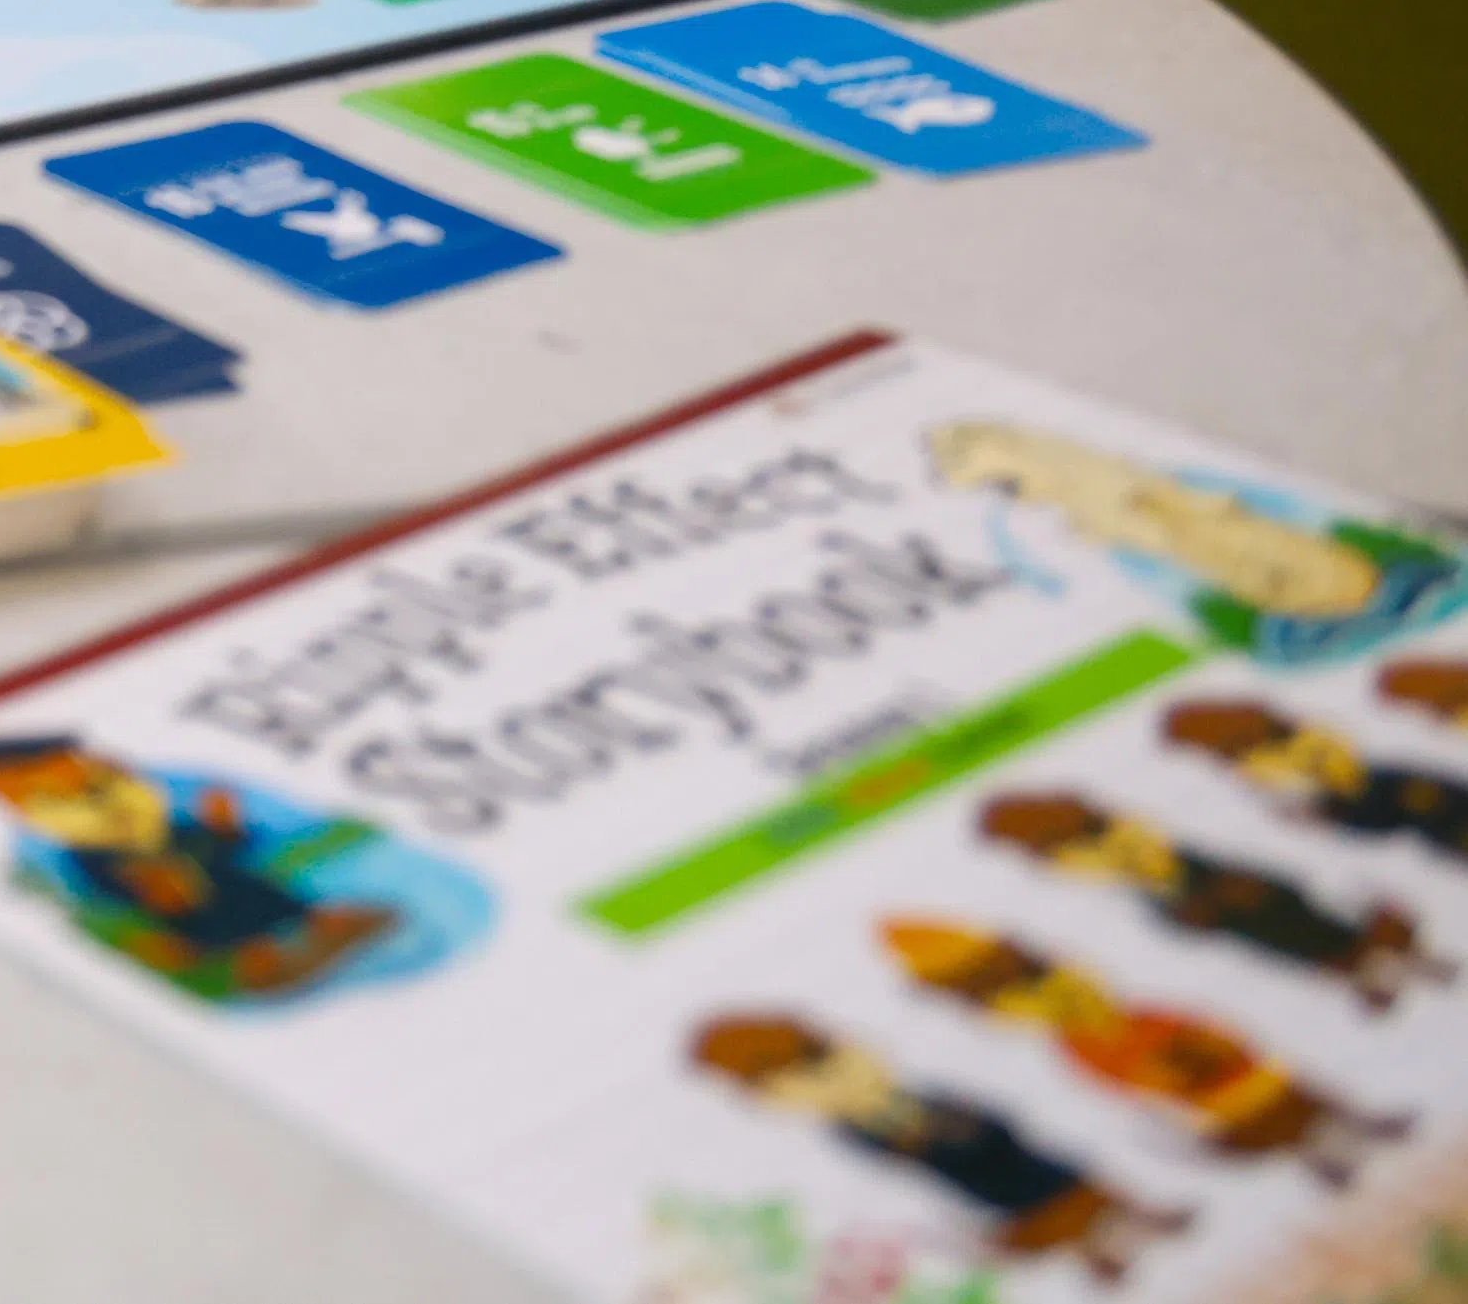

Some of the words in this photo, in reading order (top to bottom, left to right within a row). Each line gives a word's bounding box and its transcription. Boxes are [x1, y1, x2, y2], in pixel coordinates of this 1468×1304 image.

[181, 553, 552, 764] Ripple
[494, 444, 902, 588] Effect
[342, 526, 1010, 840] Storybook
